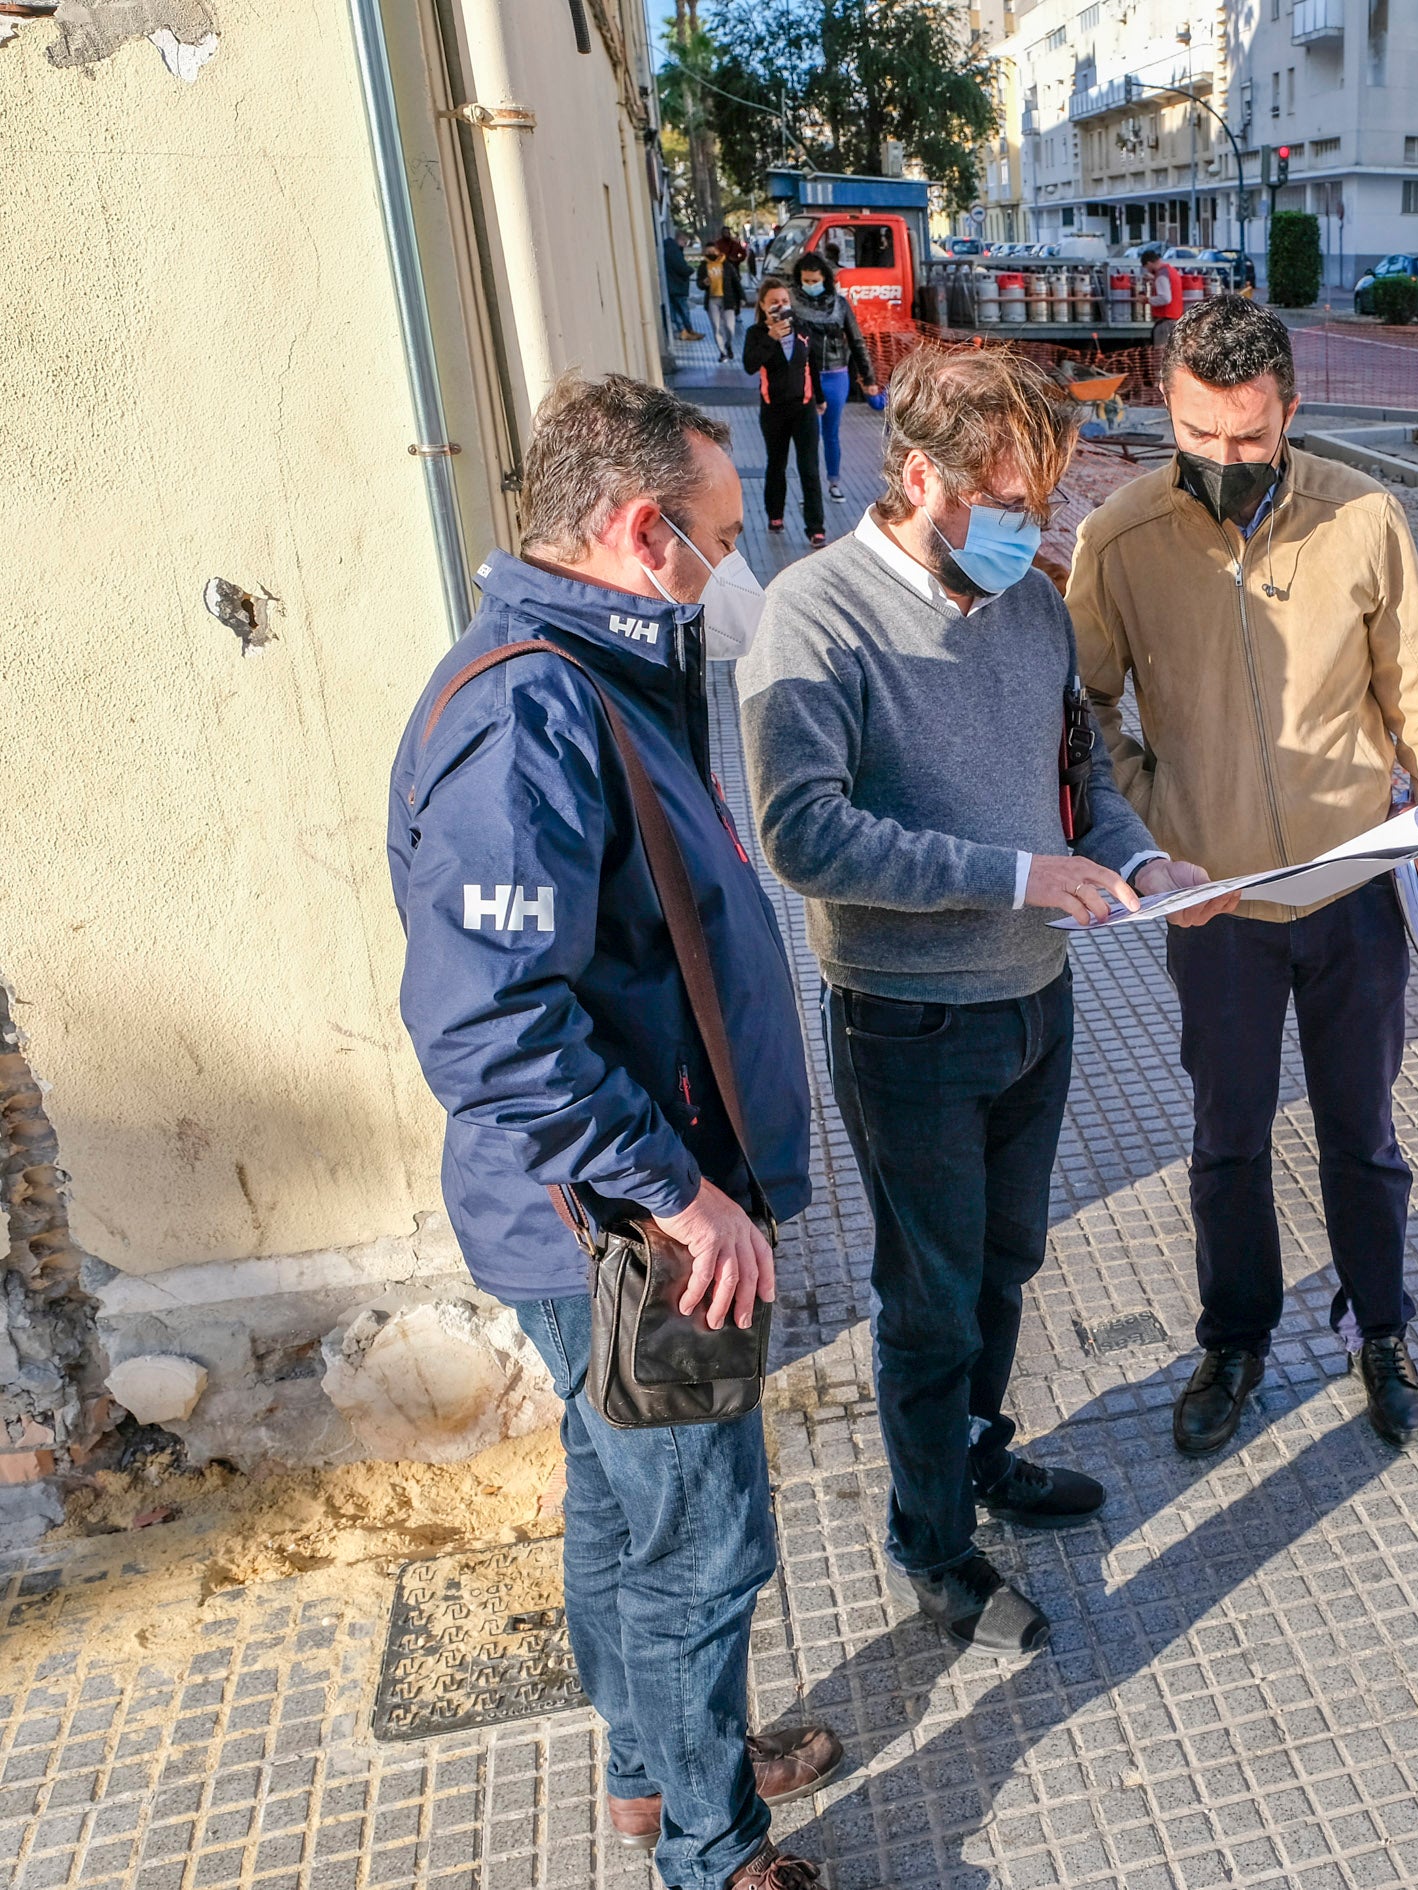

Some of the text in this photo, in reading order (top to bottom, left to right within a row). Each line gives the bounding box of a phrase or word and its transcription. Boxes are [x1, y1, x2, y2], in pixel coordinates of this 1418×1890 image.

[848, 285, 902, 305] CEPSA
[609, 614, 659, 644] HH
[463, 884, 554, 931] HH
